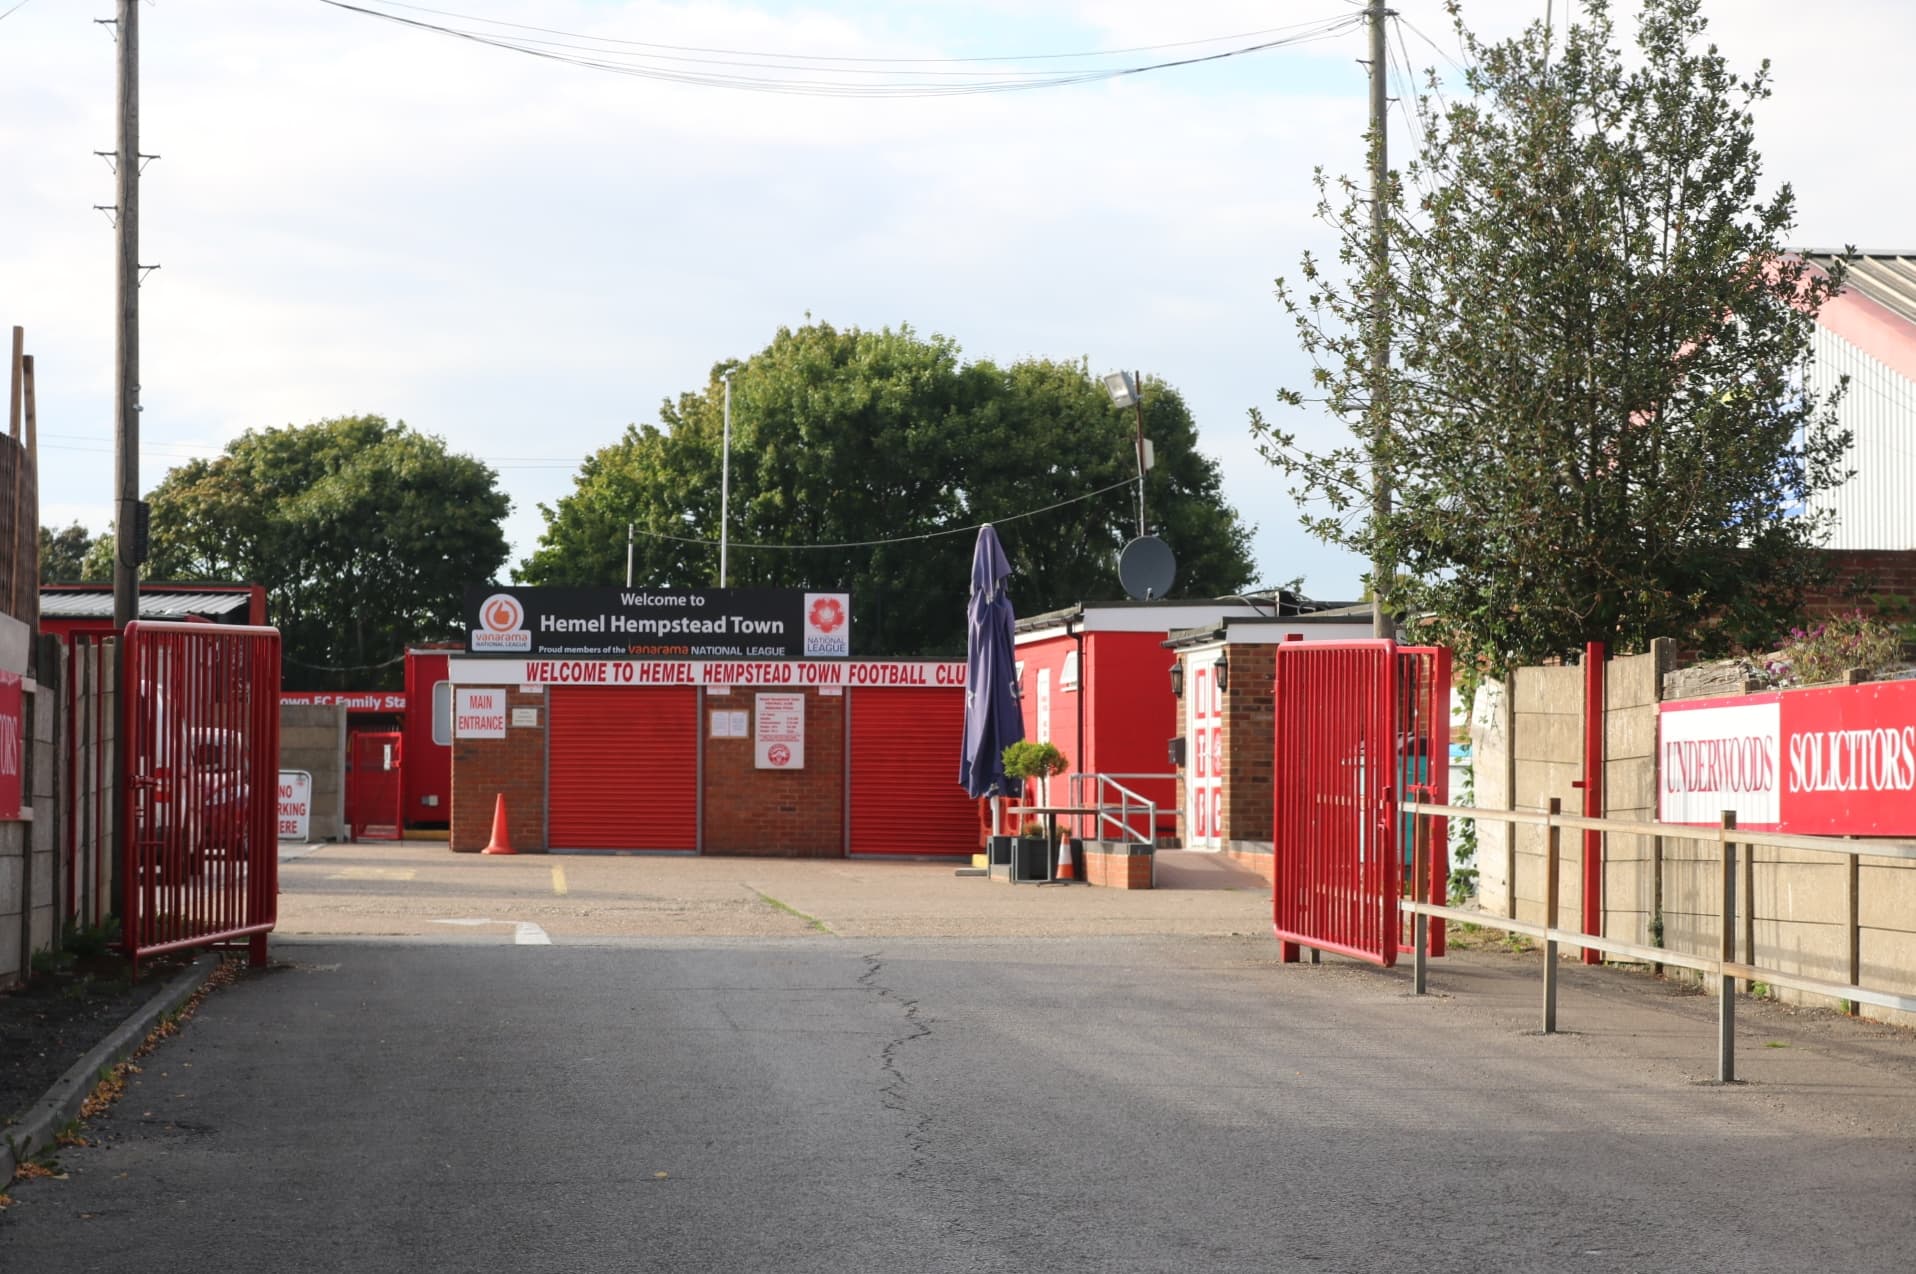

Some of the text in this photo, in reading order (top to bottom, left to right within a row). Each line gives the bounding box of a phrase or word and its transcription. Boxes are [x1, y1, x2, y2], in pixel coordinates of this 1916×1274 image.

[620, 592, 705, 607] Welcome to
[540, 614, 784, 637] Hemel Hempstead Town
[476, 633, 528, 642] vanarama
[538, 645, 785, 656] Proud members of the vanarama NATIONAL LEAGUE
[807, 643, 846, 652] LEAGUE
[526, 662, 966, 684] WELCOME TO HEMEL HEMPSTEAD TOWN FOOTBALL CLU
[336, 696, 381, 711] Family
[385, 696, 406, 708] Sta
[470, 695, 492, 709] MAIN
[459, 716, 503, 730] ENTRANCE
[0, 714, 17, 776] ORS
[1666, 726, 1915, 793] UNDERWOODS SOLICITORS
[279, 785, 292, 798] NO
[278, 803, 306, 816] RKING
[280, 821, 297, 833] ERE
